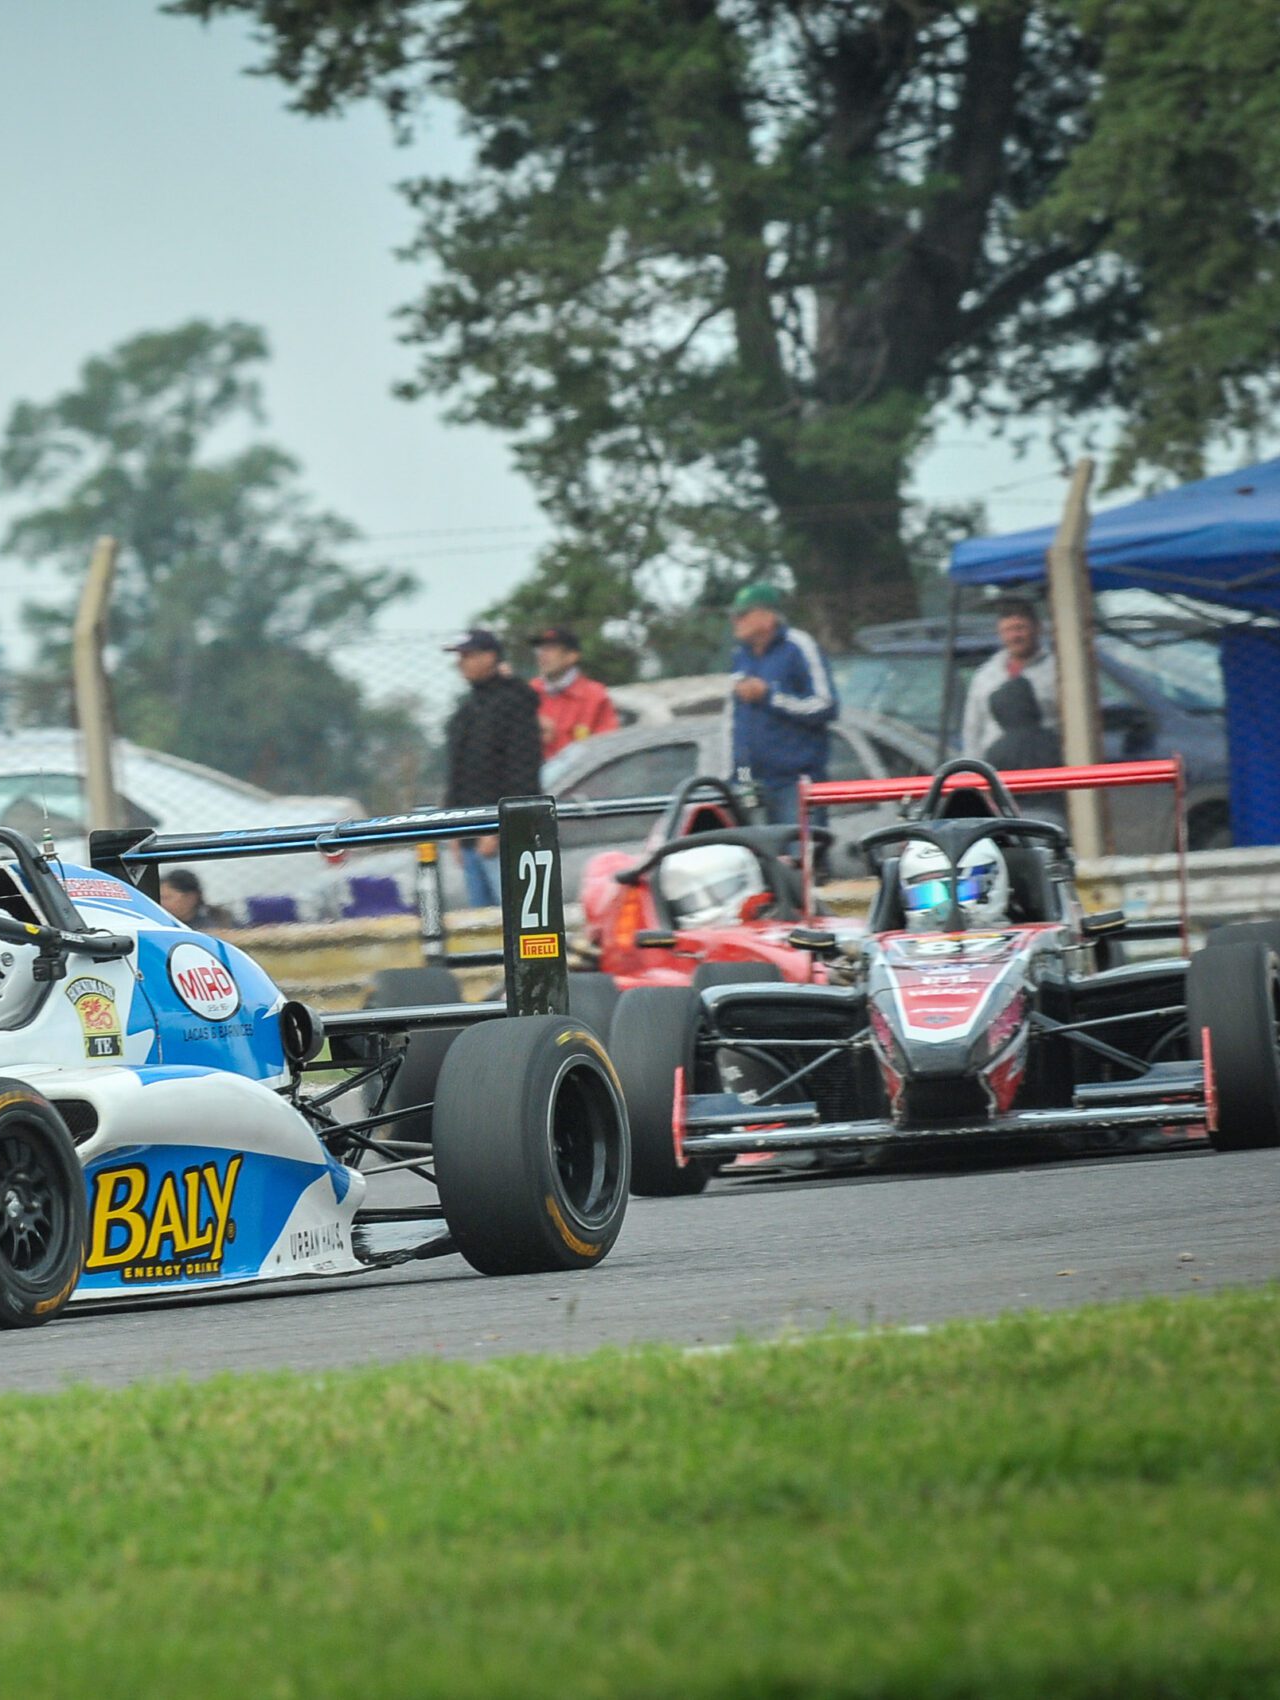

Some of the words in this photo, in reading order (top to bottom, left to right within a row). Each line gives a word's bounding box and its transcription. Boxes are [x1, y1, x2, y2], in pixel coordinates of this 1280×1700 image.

[519, 849, 554, 929] 27
[522, 937, 557, 956] PIRELLI
[182, 1027, 210, 1043] LACAS
[94, 1036, 114, 1056] TE
[84, 1155, 243, 1271] BALY
[124, 1263, 182, 1279] ENERGY
[185, 1261, 220, 1275] DRINK
